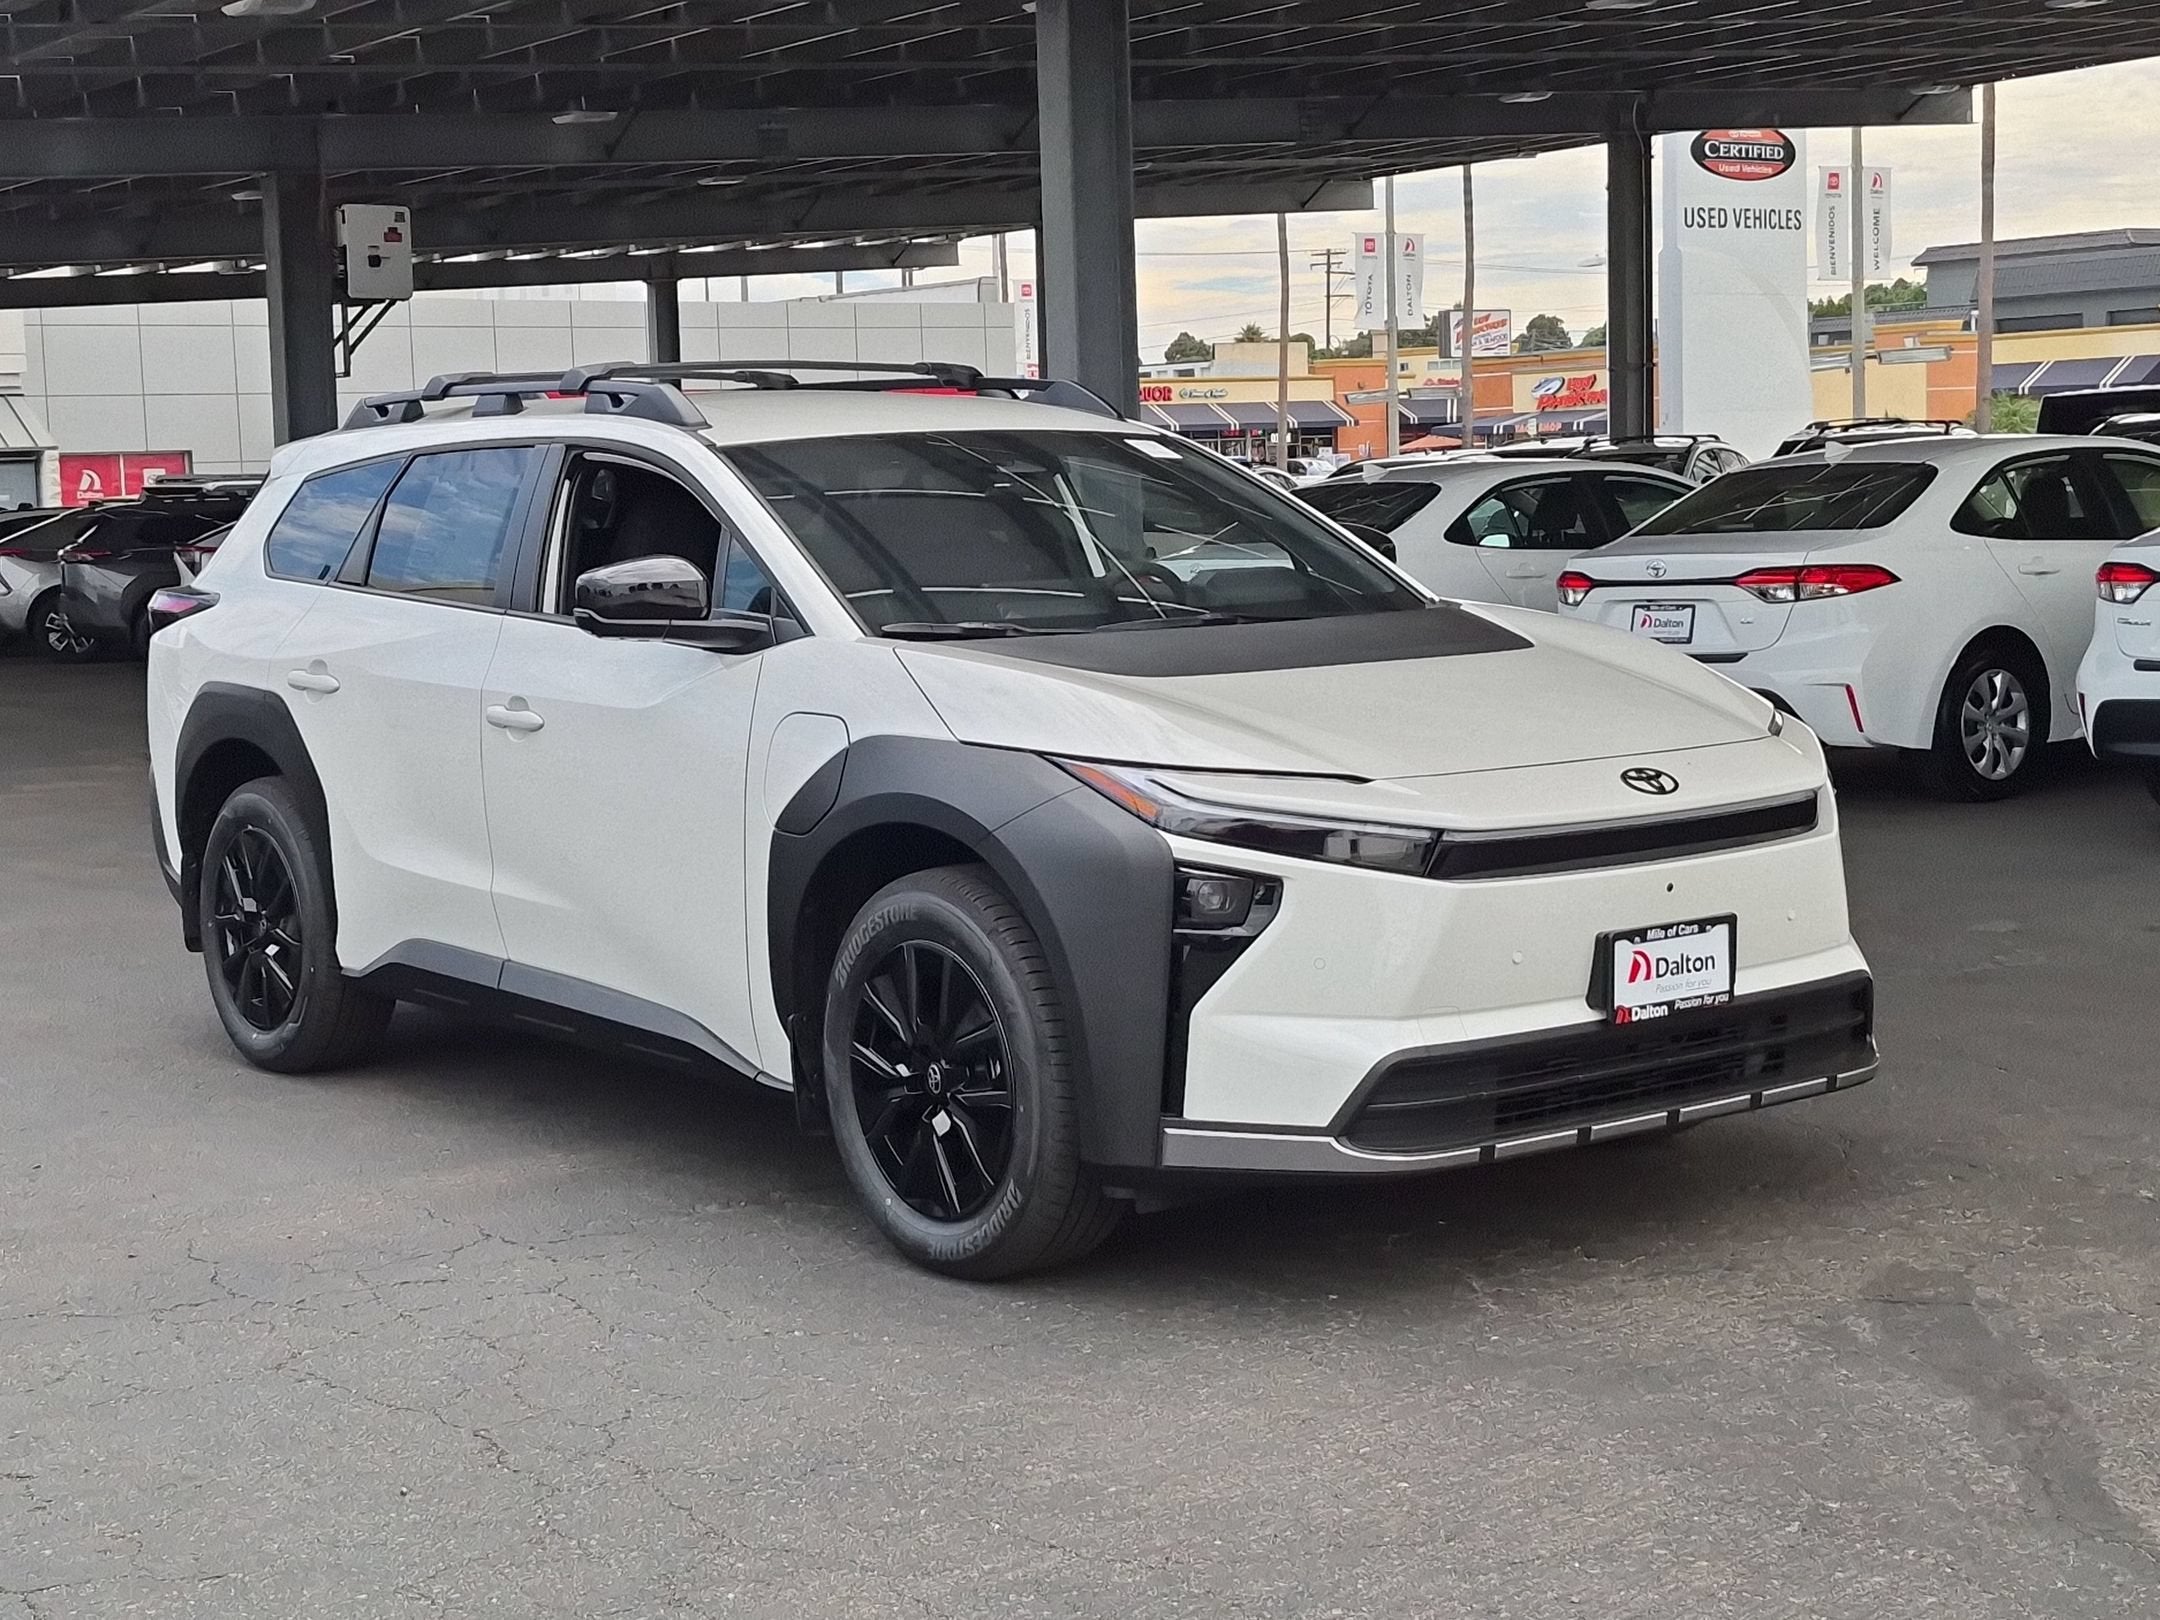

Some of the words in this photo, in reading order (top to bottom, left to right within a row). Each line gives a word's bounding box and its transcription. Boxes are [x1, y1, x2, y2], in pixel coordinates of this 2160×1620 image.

[1704, 141, 1784, 159] CERTIFIED
[1719, 164, 1740, 172] Used
[1684, 207, 1728, 228] USED
[1733, 208, 1802, 230] VEHICLES
[1828, 205, 1837, 275] BIENVENIDOS
[1872, 208, 1880, 270] WELCOME
[1365, 273, 1374, 316] TOYOTA
[1406, 274, 1414, 316] DALTON
[1653, 618, 1684, 628] Dalton
[1647, 928, 1666, 940] Mile
[1667, 925, 1677, 937] of
[1678, 924, 1699, 935] Cars
[835, 903, 918, 989] BRIDGESTONE
[1656, 953, 1715, 978] Dalton
[1656, 982, 1684, 993] Passion
[1632, 1005, 1668, 1022] Dalton
[1674, 999, 1702, 1010] Passion
[1703, 994, 1715, 1005] for
[1715, 993, 1729, 1006] you
